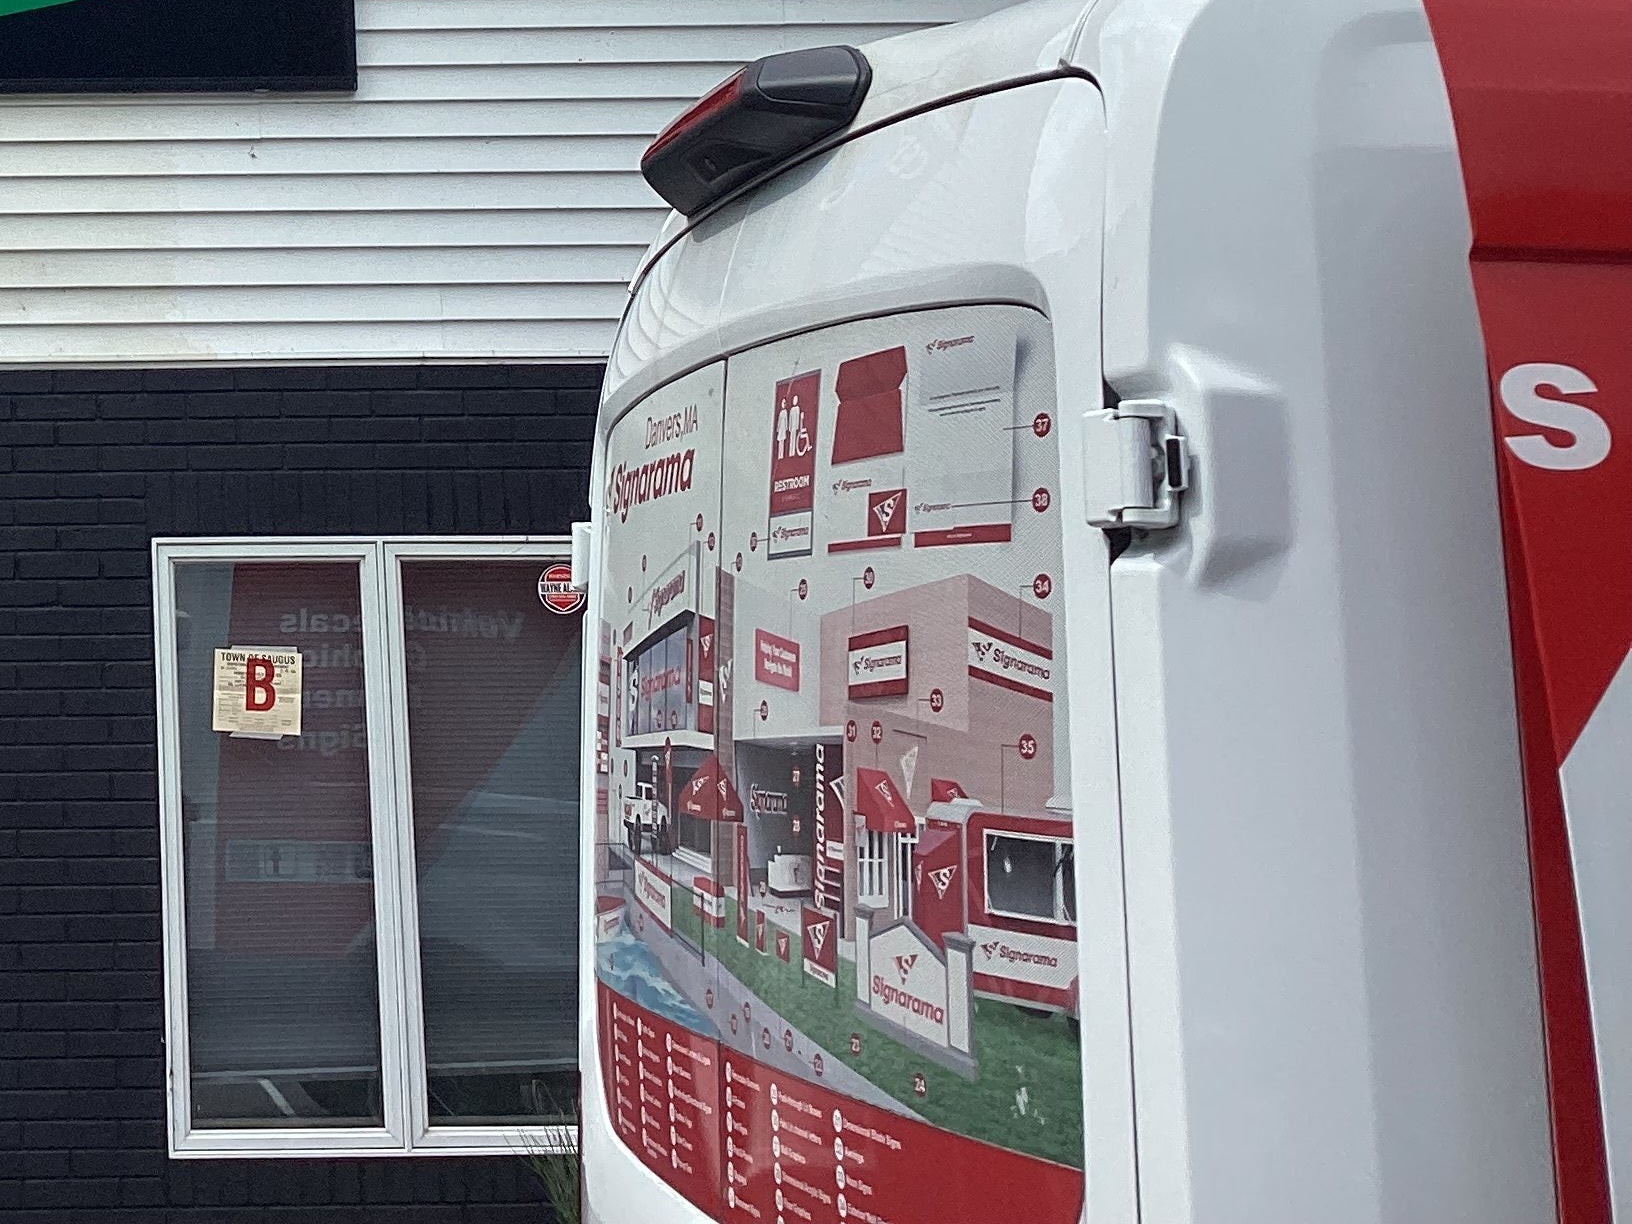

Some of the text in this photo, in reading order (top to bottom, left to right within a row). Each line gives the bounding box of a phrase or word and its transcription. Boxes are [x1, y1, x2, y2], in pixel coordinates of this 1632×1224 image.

[1034, 417, 1049, 433] 37
[1500, 362, 1612, 471] S
[612, 447, 696, 525] Signarama
[773, 475, 810, 493] RESTROOM
[1033, 493, 1048, 508] 38
[539, 582, 562, 593] WAYNE
[1034, 579, 1049, 594] 34
[221, 652, 246, 662] TOWN
[261, 654, 296, 665] SAUGUS
[992, 648, 1051, 680] Signarama
[245, 658, 276, 712] B
[872, 726, 882, 739] 32
[1020, 739, 1035, 755] 35
[813, 743, 825, 909] Signarama
[999, 944, 1058, 968] Signarama
[871, 975, 945, 1025] Signarama
